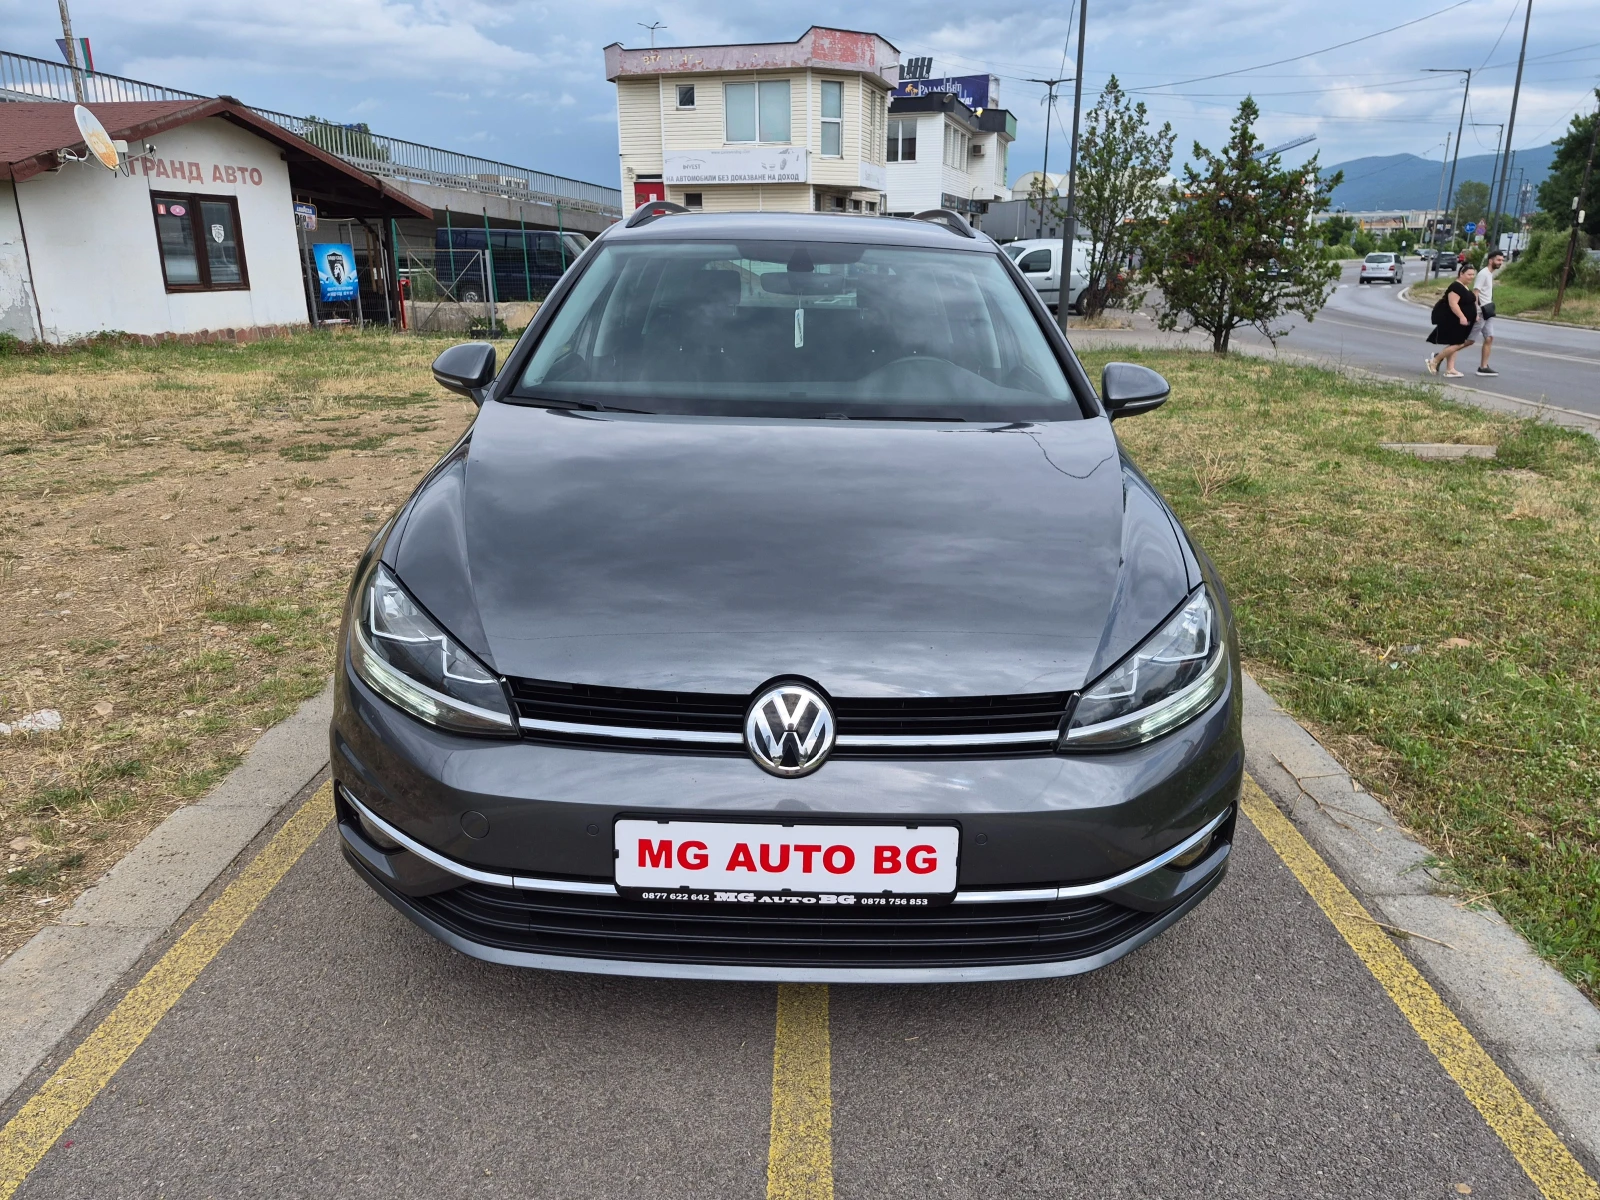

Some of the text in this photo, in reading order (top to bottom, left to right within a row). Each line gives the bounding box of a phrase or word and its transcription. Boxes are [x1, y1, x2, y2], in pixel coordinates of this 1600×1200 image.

[127, 155, 263, 186] ГРАНД АВТО
[666, 173, 799, 183] НА АВТОМОБИЛИ БЕЗ ДОКАЗВАНЕ НА ДОХОД
[637, 838, 938, 875] MG AUTO BG
[642, 892, 667, 900] 0877
[713, 891, 756, 902] MG
[758, 896, 817, 904] AUTO
[818, 894, 857, 905] BG
